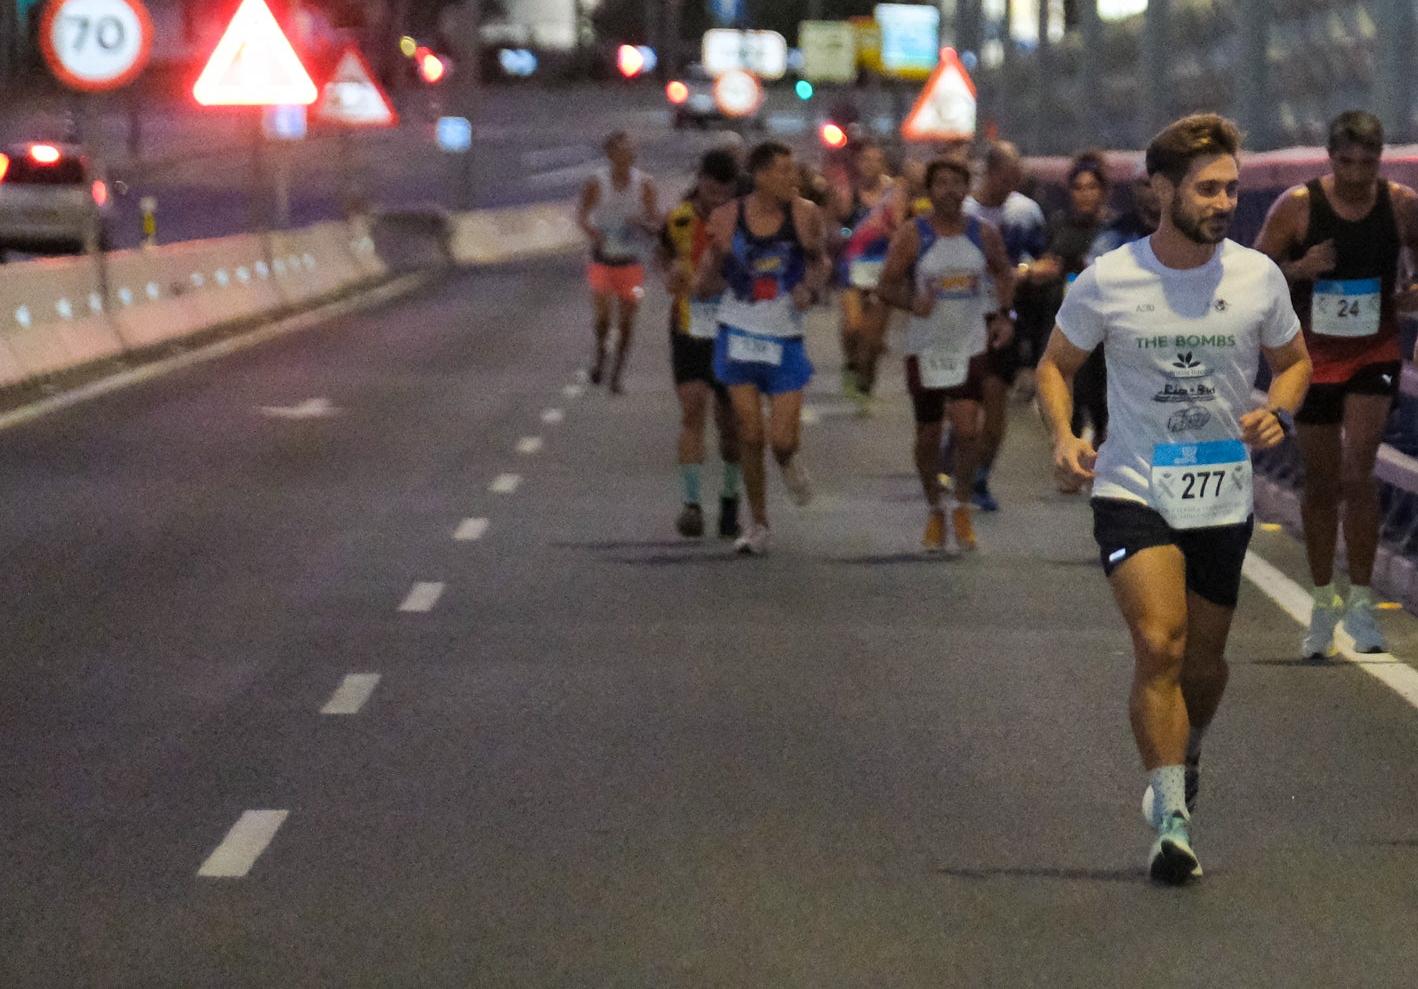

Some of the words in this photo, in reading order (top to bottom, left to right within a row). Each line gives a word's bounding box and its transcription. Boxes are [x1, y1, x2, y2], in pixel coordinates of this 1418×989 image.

[66, 13, 126, 52] 70
[1337, 298, 1360, 318] 24
[1136, 336, 1168, 349] THE
[1175, 334, 1236, 349] BOMBS
[1181, 470, 1226, 500] 277
